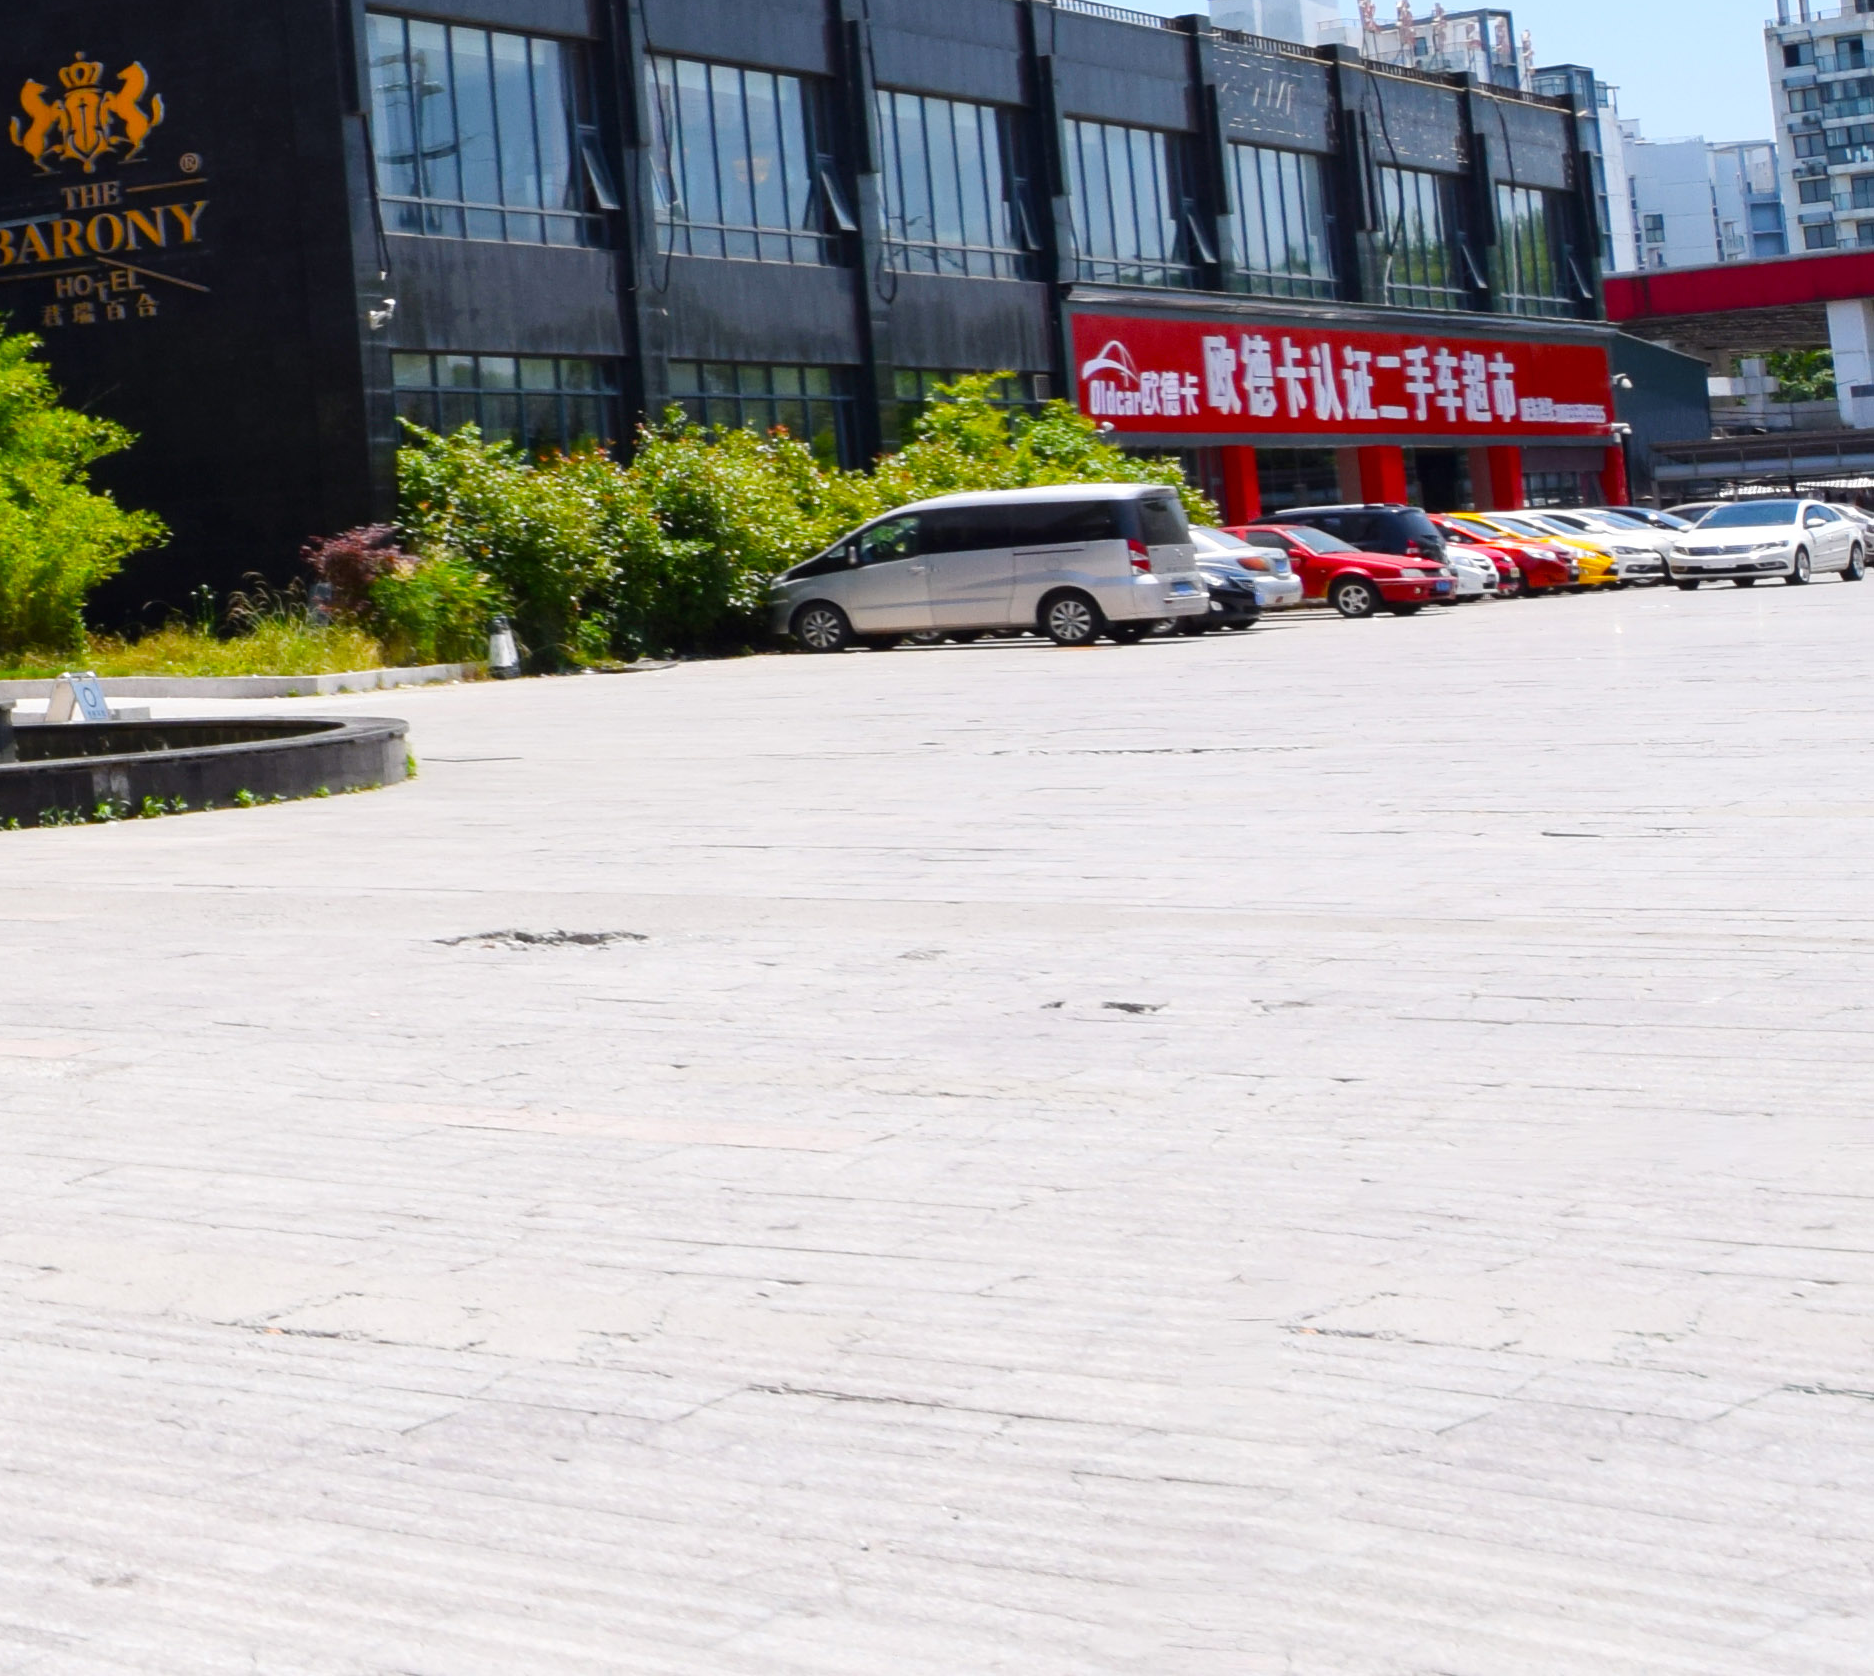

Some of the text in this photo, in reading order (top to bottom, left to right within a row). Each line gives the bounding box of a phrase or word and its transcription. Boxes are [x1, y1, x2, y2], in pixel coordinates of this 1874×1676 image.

[60, 180, 122, 210] THE
[55, 267, 146, 303] HOTEL
[1202, 333, 1516, 423] 欧德卡认证二手车超市
